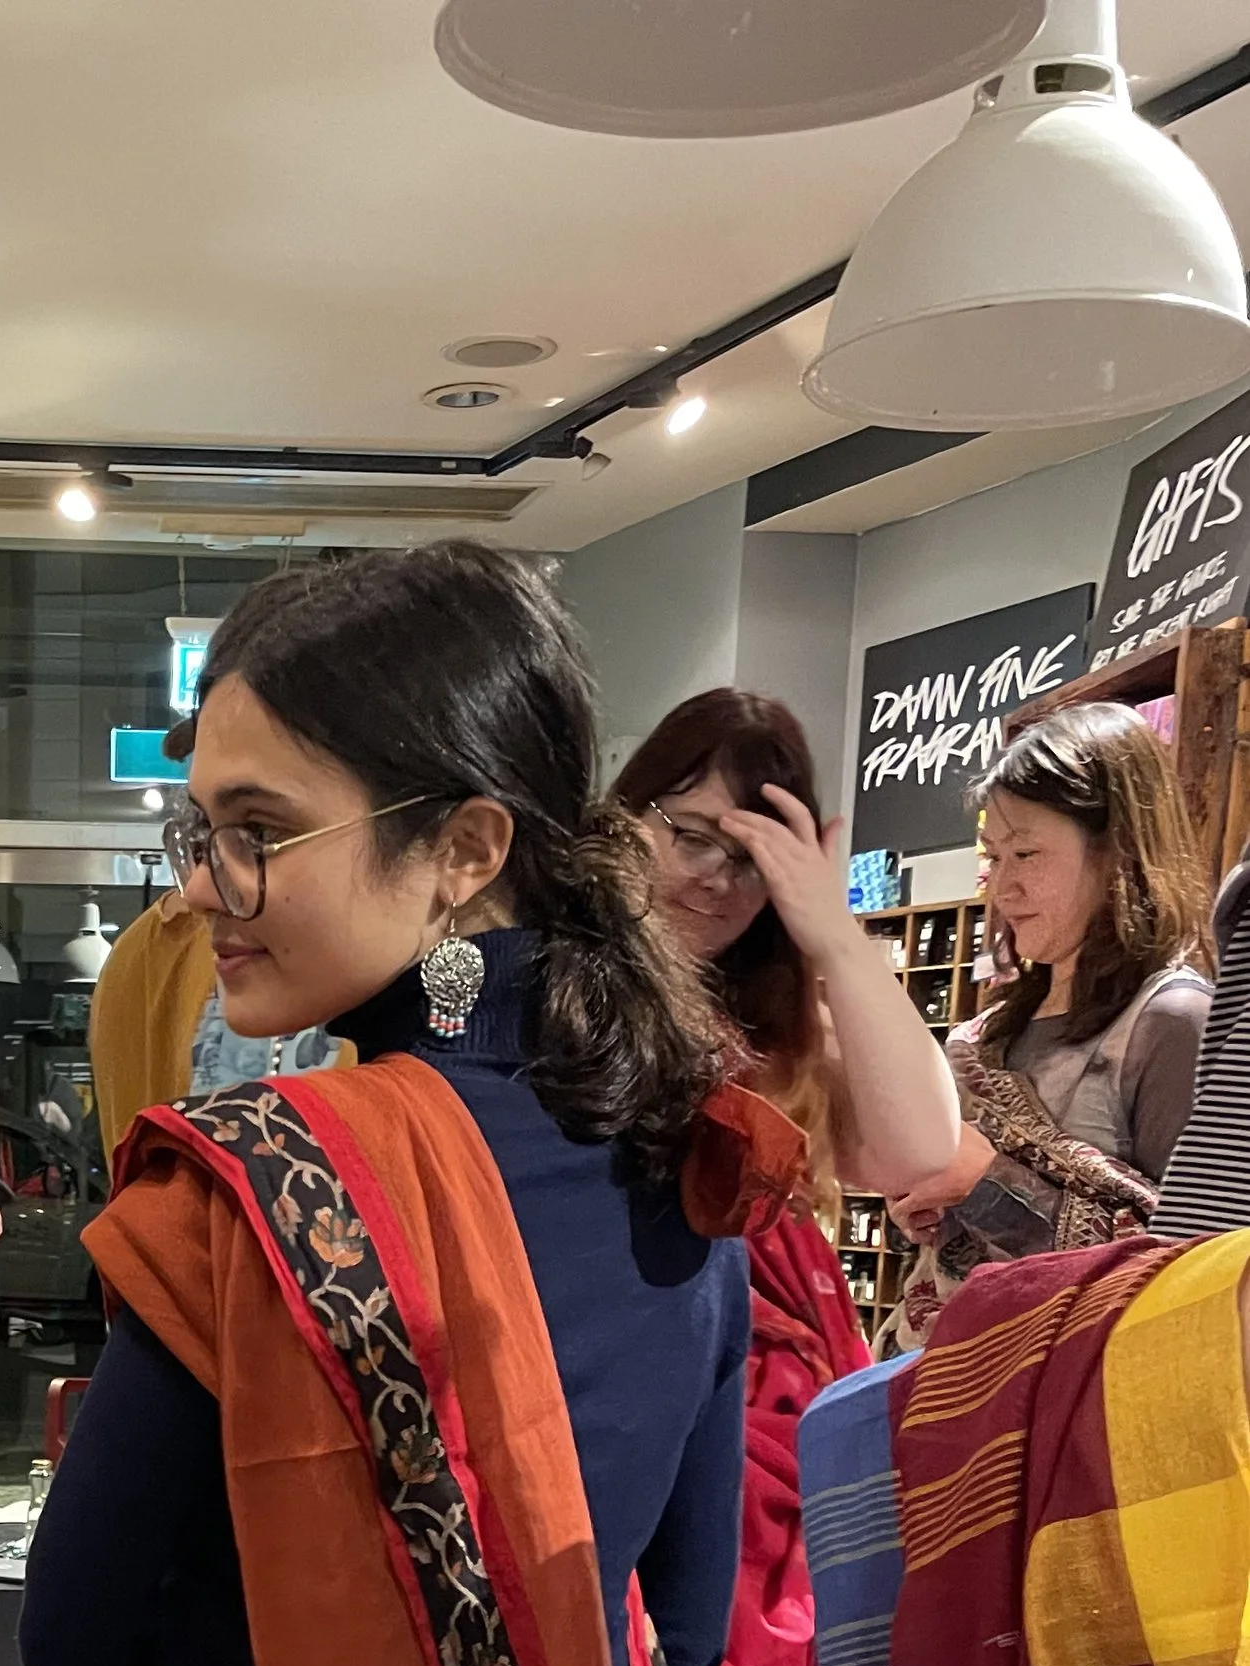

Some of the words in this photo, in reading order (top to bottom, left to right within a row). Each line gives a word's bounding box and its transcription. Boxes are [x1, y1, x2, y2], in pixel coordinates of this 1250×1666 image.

[1127, 435, 1250, 578] GIFTS
[870, 665, 976, 733] DAMN
[978, 634, 1077, 712] FINE
